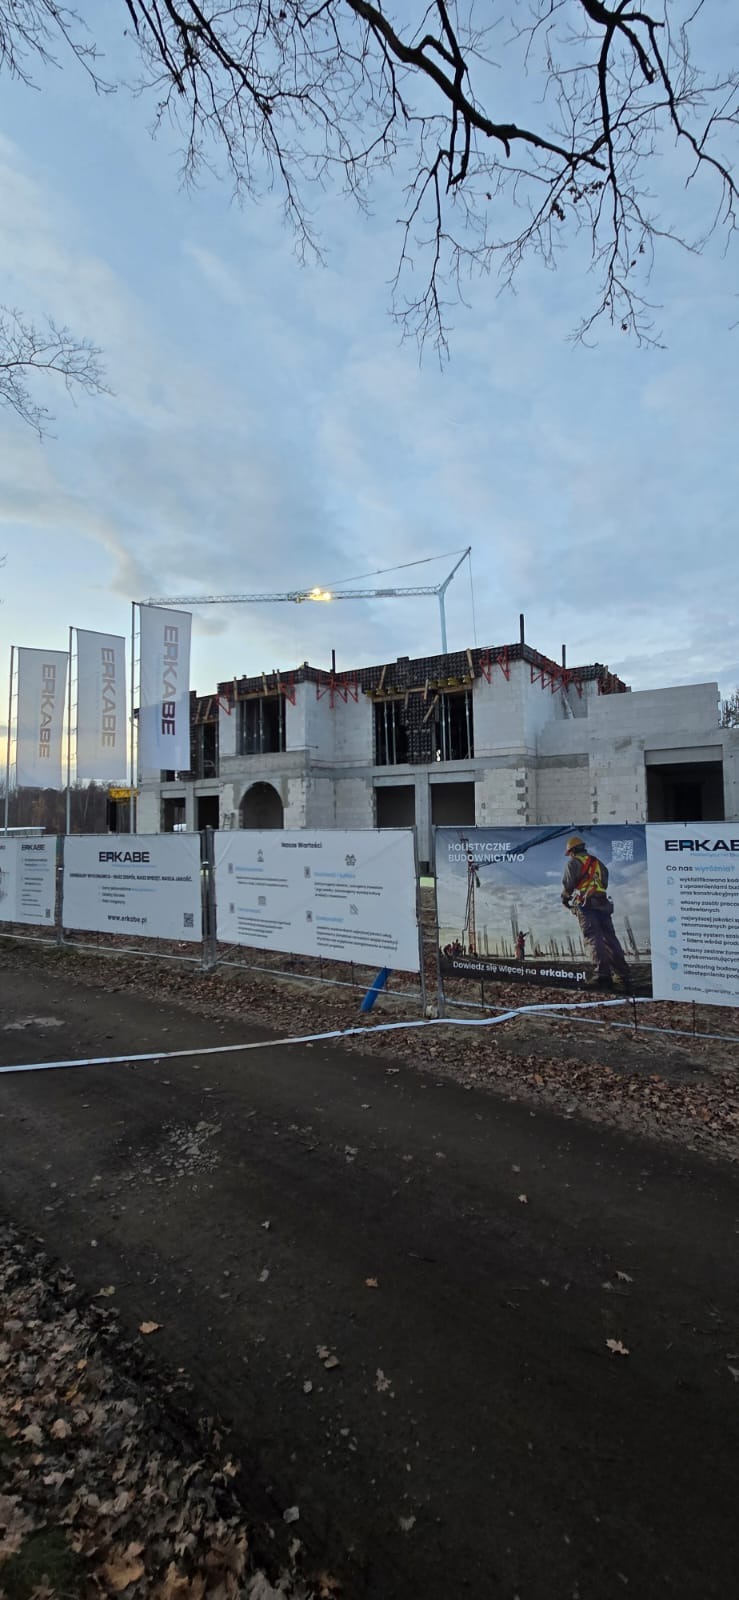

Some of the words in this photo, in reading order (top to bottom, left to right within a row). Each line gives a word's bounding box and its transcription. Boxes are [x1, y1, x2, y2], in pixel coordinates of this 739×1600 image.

[162, 626, 178, 736] ERKABE
[101, 648, 116, 748] ERKABE
[39, 664, 56, 758] ERKABE
[448, 842, 511, 851] HOLISTYCZNE
[98, 851, 150, 862] ERKABE
[448, 854, 524, 862] BUDOWNICTWO
[694, 864, 735, 873] wyróżnia?
[108, 914, 147, 925] www.erkabe.pl
[453, 961, 485, 971] Dowiedz
[486, 964, 498, 973] się
[499, 964, 524, 976] więcej
[540, 968, 586, 981] erkabe.pl
